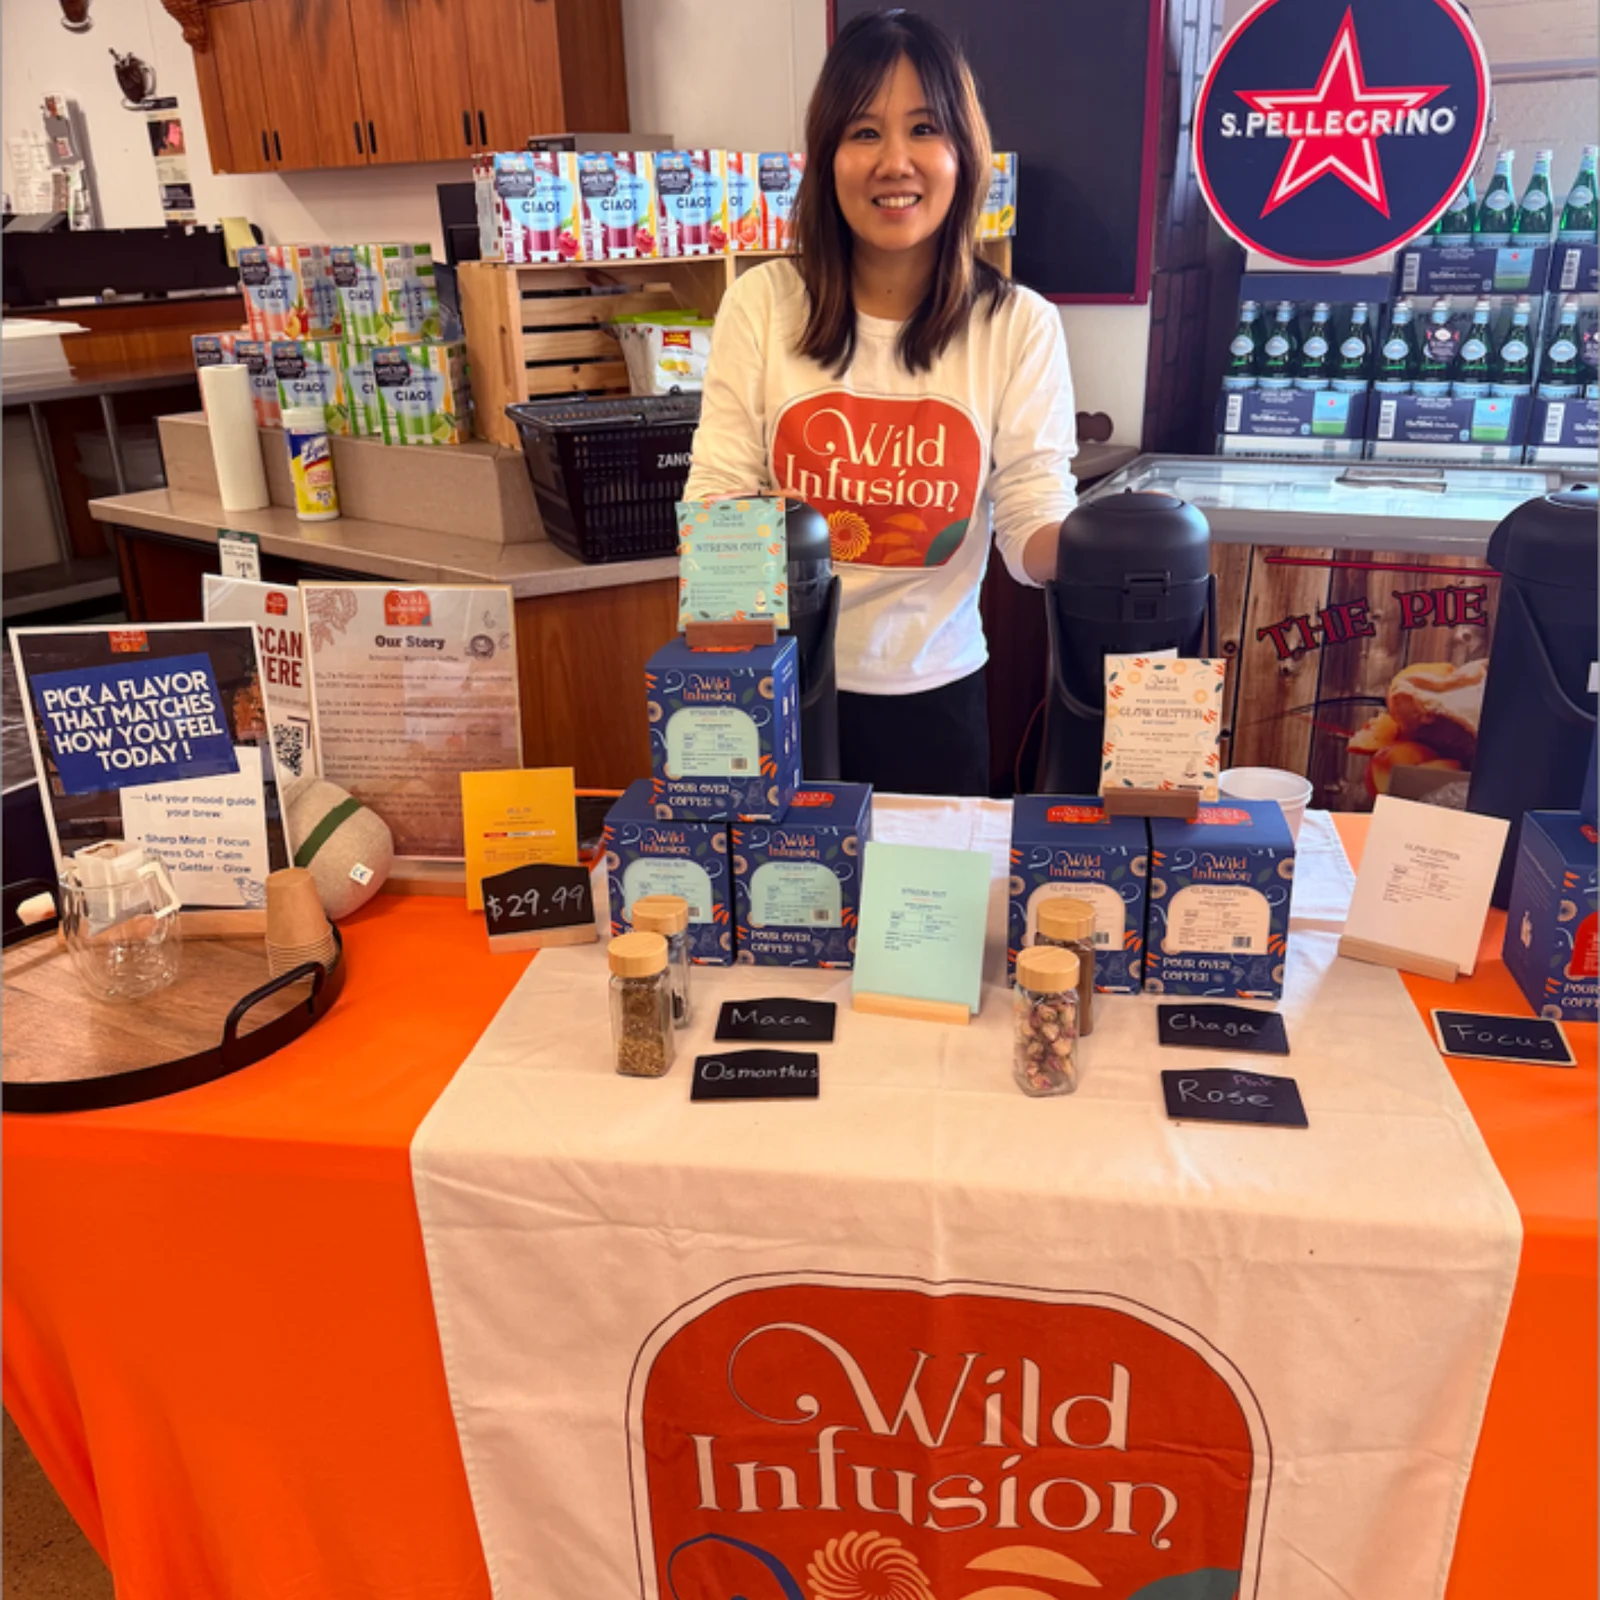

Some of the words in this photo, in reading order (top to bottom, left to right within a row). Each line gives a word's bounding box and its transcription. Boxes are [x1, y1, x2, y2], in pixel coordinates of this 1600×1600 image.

[522, 200, 560, 213] CIAO!
[600, 198, 637, 211] CIAO!
[676, 196, 711, 209] CIAO!
[803, 408, 946, 467] Wild
[786, 453, 961, 513] Infusion
[1256, 597, 1377, 662] THE
[1391, 583, 1489, 631] PIE
[375, 635, 401, 648] Our
[406, 635, 445, 650] Story
[43, 685, 93, 711] PICK
[100, 681, 117, 704] A
[118, 670, 209, 702] FLAVOR
[688, 673, 731, 691] Wild
[683, 687, 737, 704] Infusion
[48, 706, 109, 733] THAT
[112, 693, 215, 727] MATCHES
[55, 728, 113, 755] HOW
[118, 721, 172, 746] YOU
[176, 715, 224, 740] FEEL
[667, 782, 697, 794] POUR
[700, 784, 730, 796] OVER
[145, 792, 162, 802] Let
[165, 795, 189, 804] your
[192, 795, 224, 804] mood
[226, 796, 257, 807] guide
[166, 809, 190, 818] your
[145, 834, 177, 845] Sharp
[179, 835, 206, 845] Mind
[217, 836, 251, 847] Focus
[643, 827, 685, 843] Wild
[771, 830, 816, 847] Wild
[184, 848, 205, 858] Out
[215, 849, 243, 859] Calm
[1055, 850, 1101, 867] Wild
[1200, 852, 1247, 869] Wild
[179, 862, 213, 872] Getter
[223, 863, 251, 873] Glow
[1049, 864, 1106, 880] Infusion
[1192, 866, 1252, 882] Infusion
[486, 884, 585, 923] $29.99
[751, 930, 779, 940] POUR
[1163, 957, 1196, 969] POUR
[731, 1008, 811, 1026] Maca
[1168, 1013, 1260, 1037] Chaga
[701, 1060, 819, 1081] Osmanthus
[1178, 1078, 1274, 1108] Rose
[728, 1322, 1131, 1452] Wild
[686, 1424, 1179, 1551] Infusion
